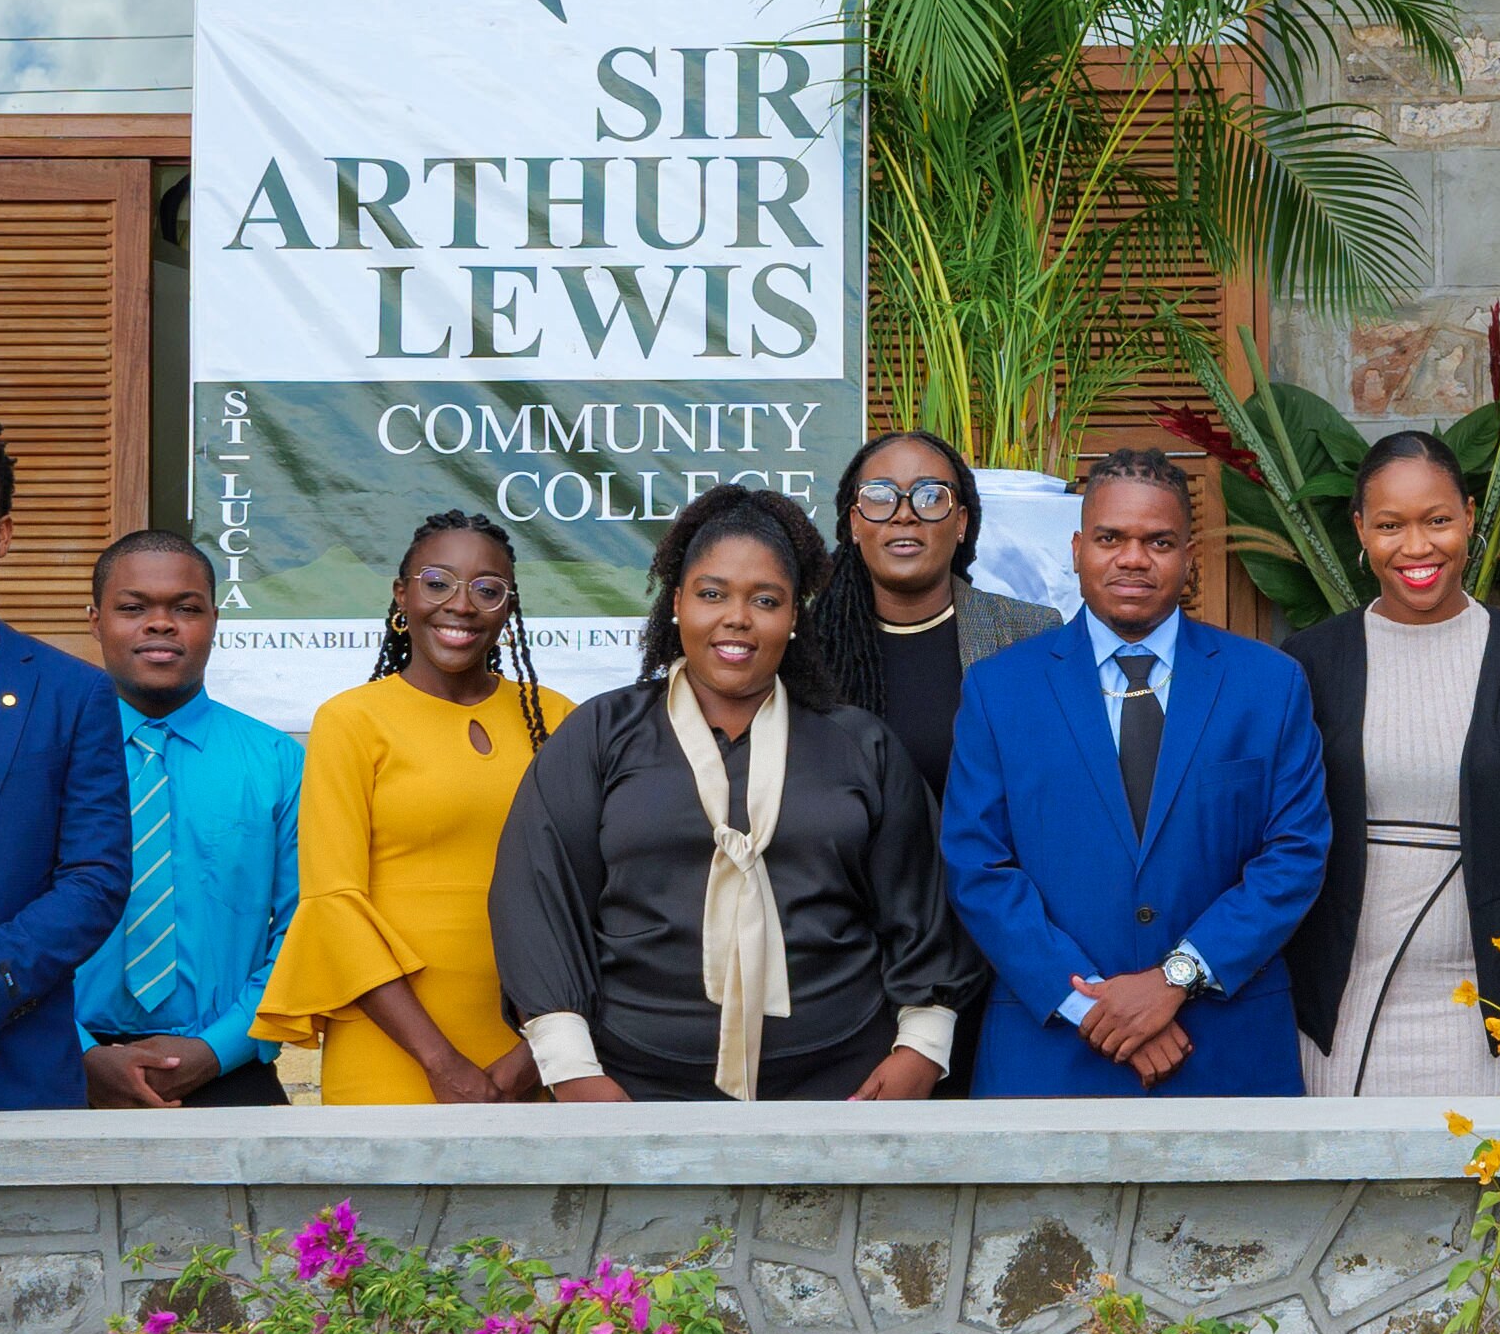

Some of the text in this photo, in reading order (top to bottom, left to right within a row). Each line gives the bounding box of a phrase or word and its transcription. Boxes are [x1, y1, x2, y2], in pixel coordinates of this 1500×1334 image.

[596, 46, 824, 142] SIR
[222, 156, 824, 251] ARTHUR
[366, 261, 819, 361] LEWIS
[377, 401, 822, 456] COMMUNITY
[497, 470, 818, 523] COLLEE
[211, 631, 386, 650] USTAINABILIT
